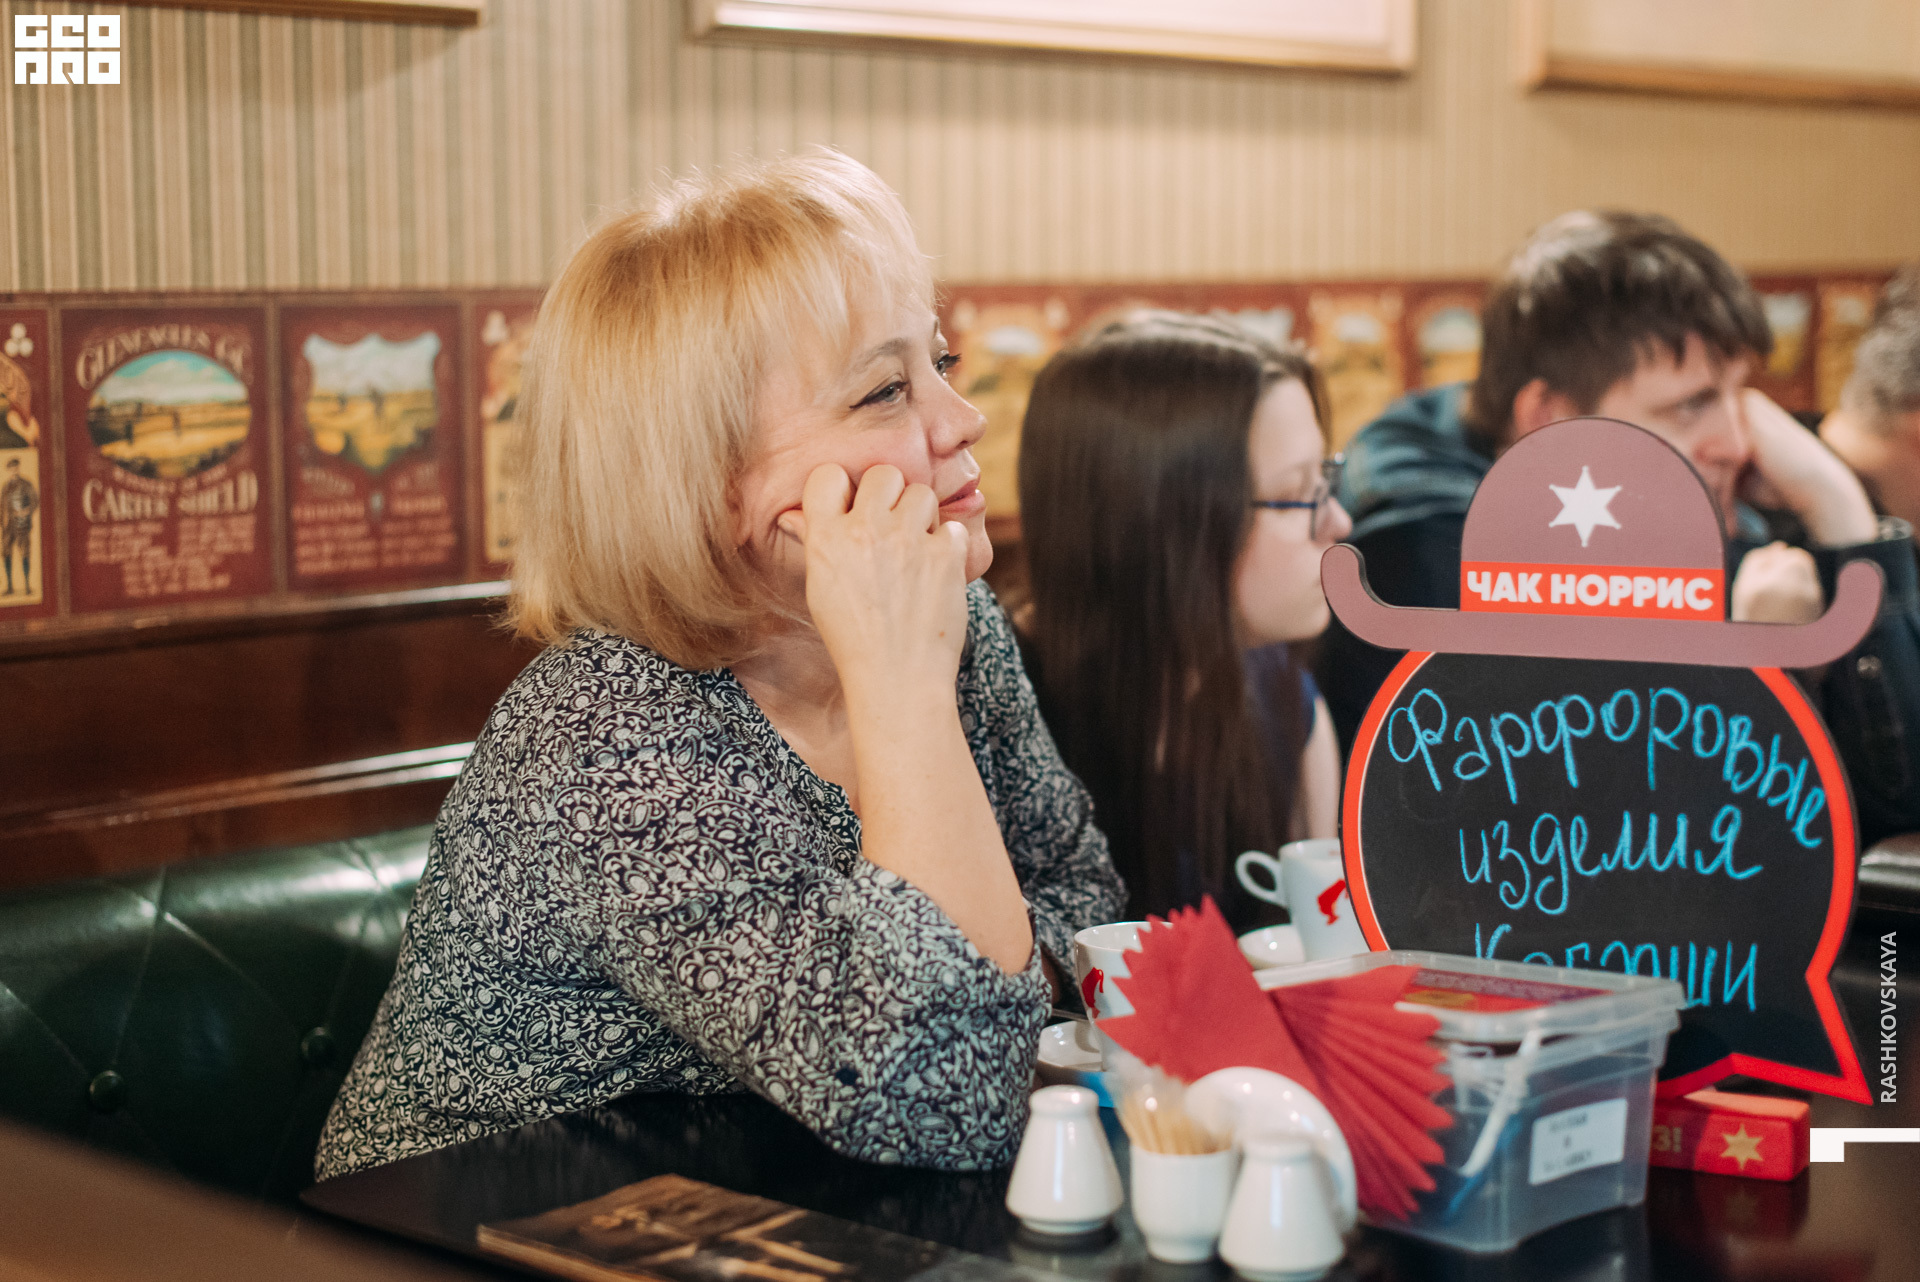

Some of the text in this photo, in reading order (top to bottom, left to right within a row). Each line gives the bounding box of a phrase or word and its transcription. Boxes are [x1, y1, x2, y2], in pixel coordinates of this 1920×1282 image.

[1467, 571, 1714, 611] ЧАК НОРРИС
[1387, 687, 1826, 848] Фарфоровые
[1459, 804, 1764, 916] изделия
